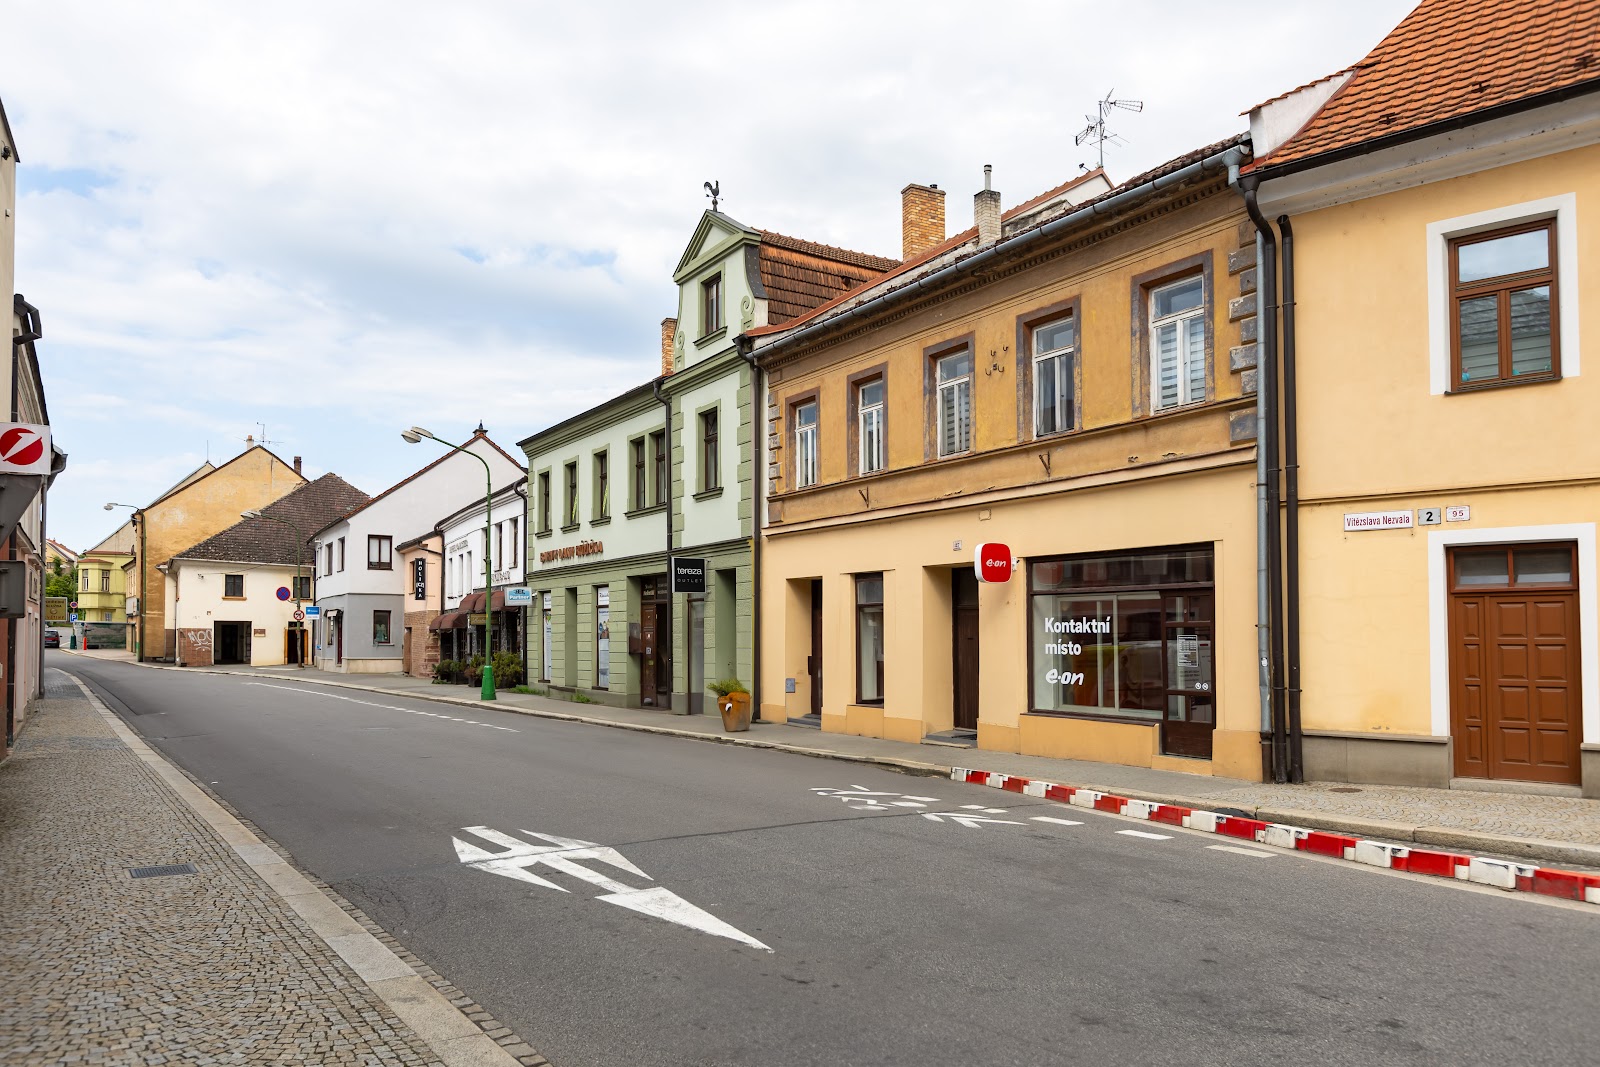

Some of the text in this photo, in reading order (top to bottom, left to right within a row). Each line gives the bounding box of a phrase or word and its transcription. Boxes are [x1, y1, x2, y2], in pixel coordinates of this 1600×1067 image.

[1425, 511, 1434, 522] 2
[1452, 509, 1464, 518] 95
[1382, 514, 1410, 525] Nezvala
[677, 566, 702, 575] tereza
[1044, 616, 1111, 634] Kontaktní
[1045, 638, 1082, 656] místo
